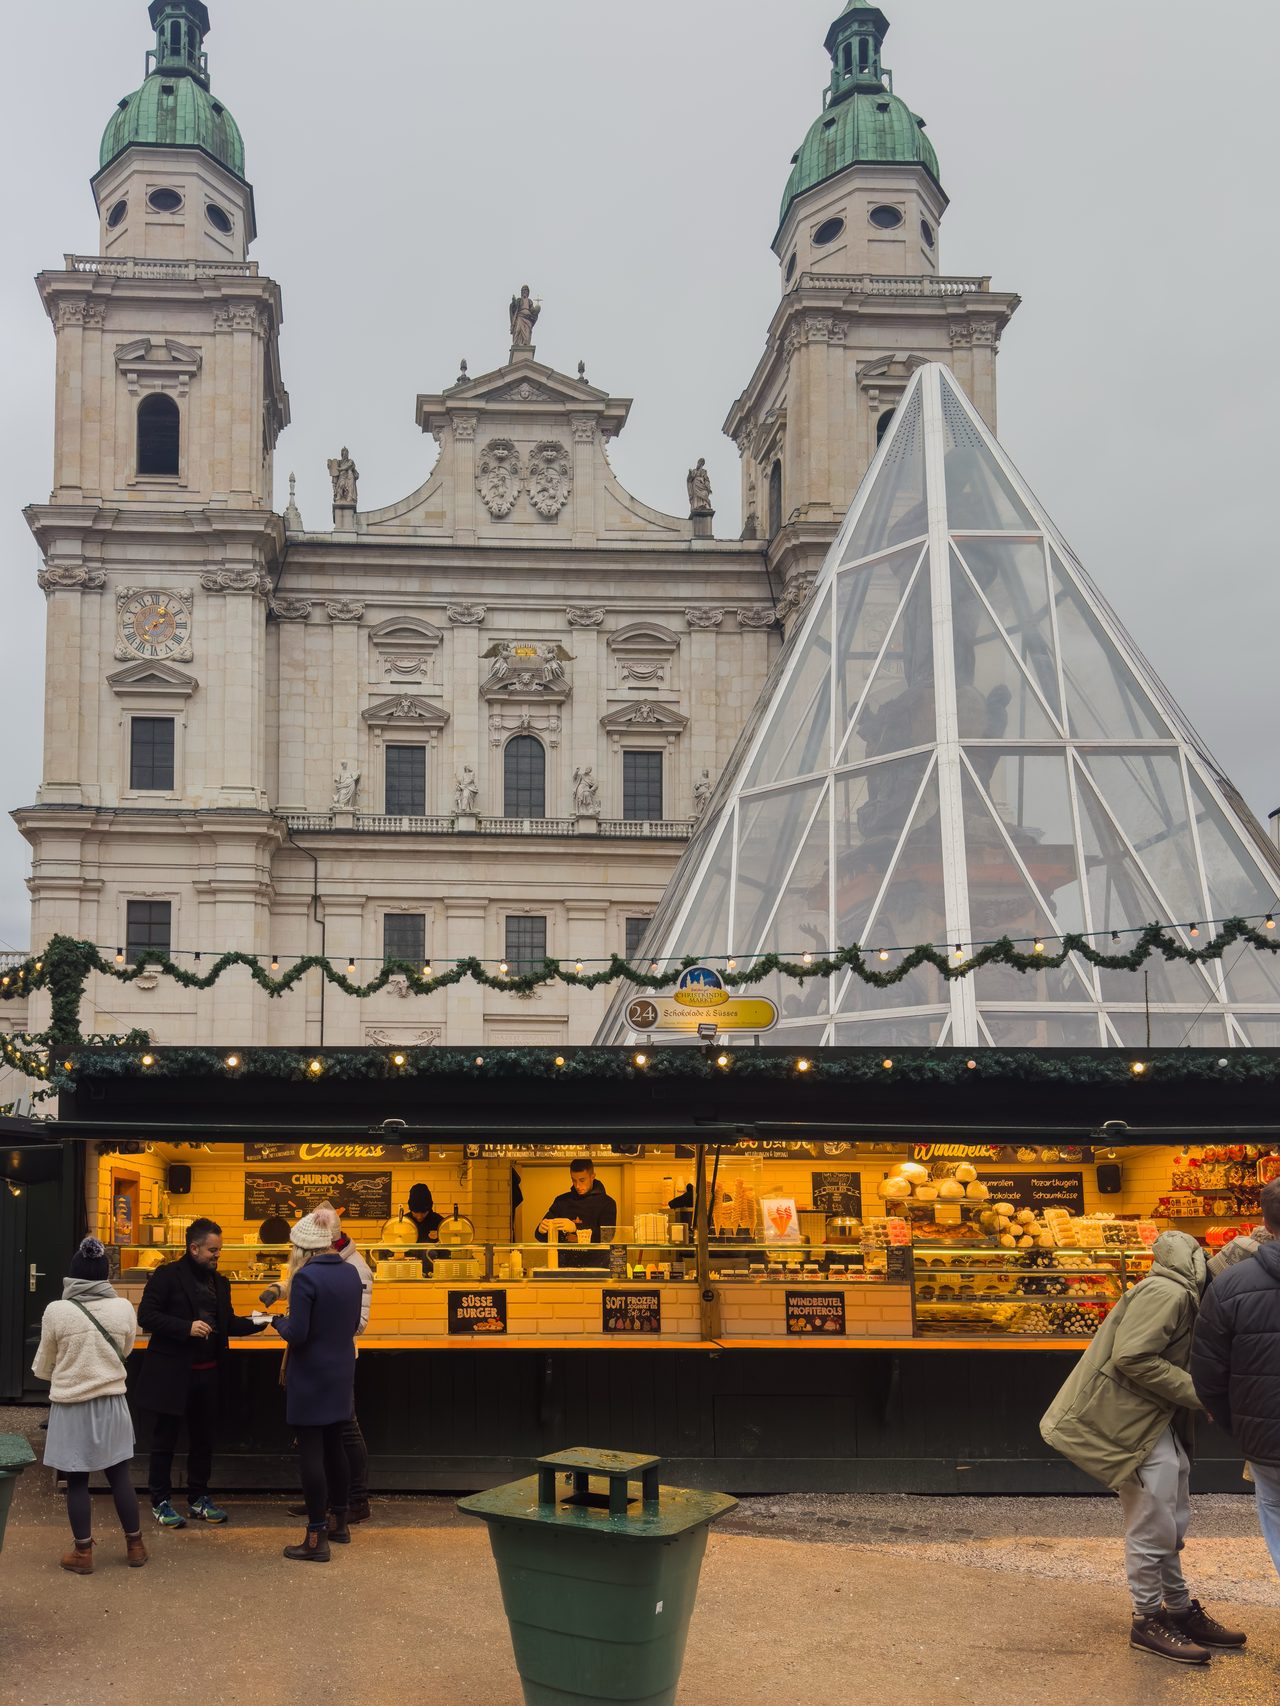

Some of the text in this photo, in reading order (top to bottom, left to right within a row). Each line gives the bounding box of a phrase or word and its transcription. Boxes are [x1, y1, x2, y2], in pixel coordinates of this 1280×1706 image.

[631, 1006, 655, 1021] 24
[663, 1009, 704, 1017] Schokolade
[712, 1009, 738, 1017] Süsses
[291, 1174, 344, 1185] CHURROS
[1031, 1179, 1079, 1188] Mozartkugeln
[1032, 1190, 1078, 1200] Schaumküsse
[461, 1294, 493, 1307] SÜSSE
[605, 1296, 658, 1309] SOFT FROZEN
[788, 1297, 842, 1306] WINDBEUTEL
[457, 1308, 498, 1319] BURGER
[788, 1307, 843, 1315] PROFITEROLS
